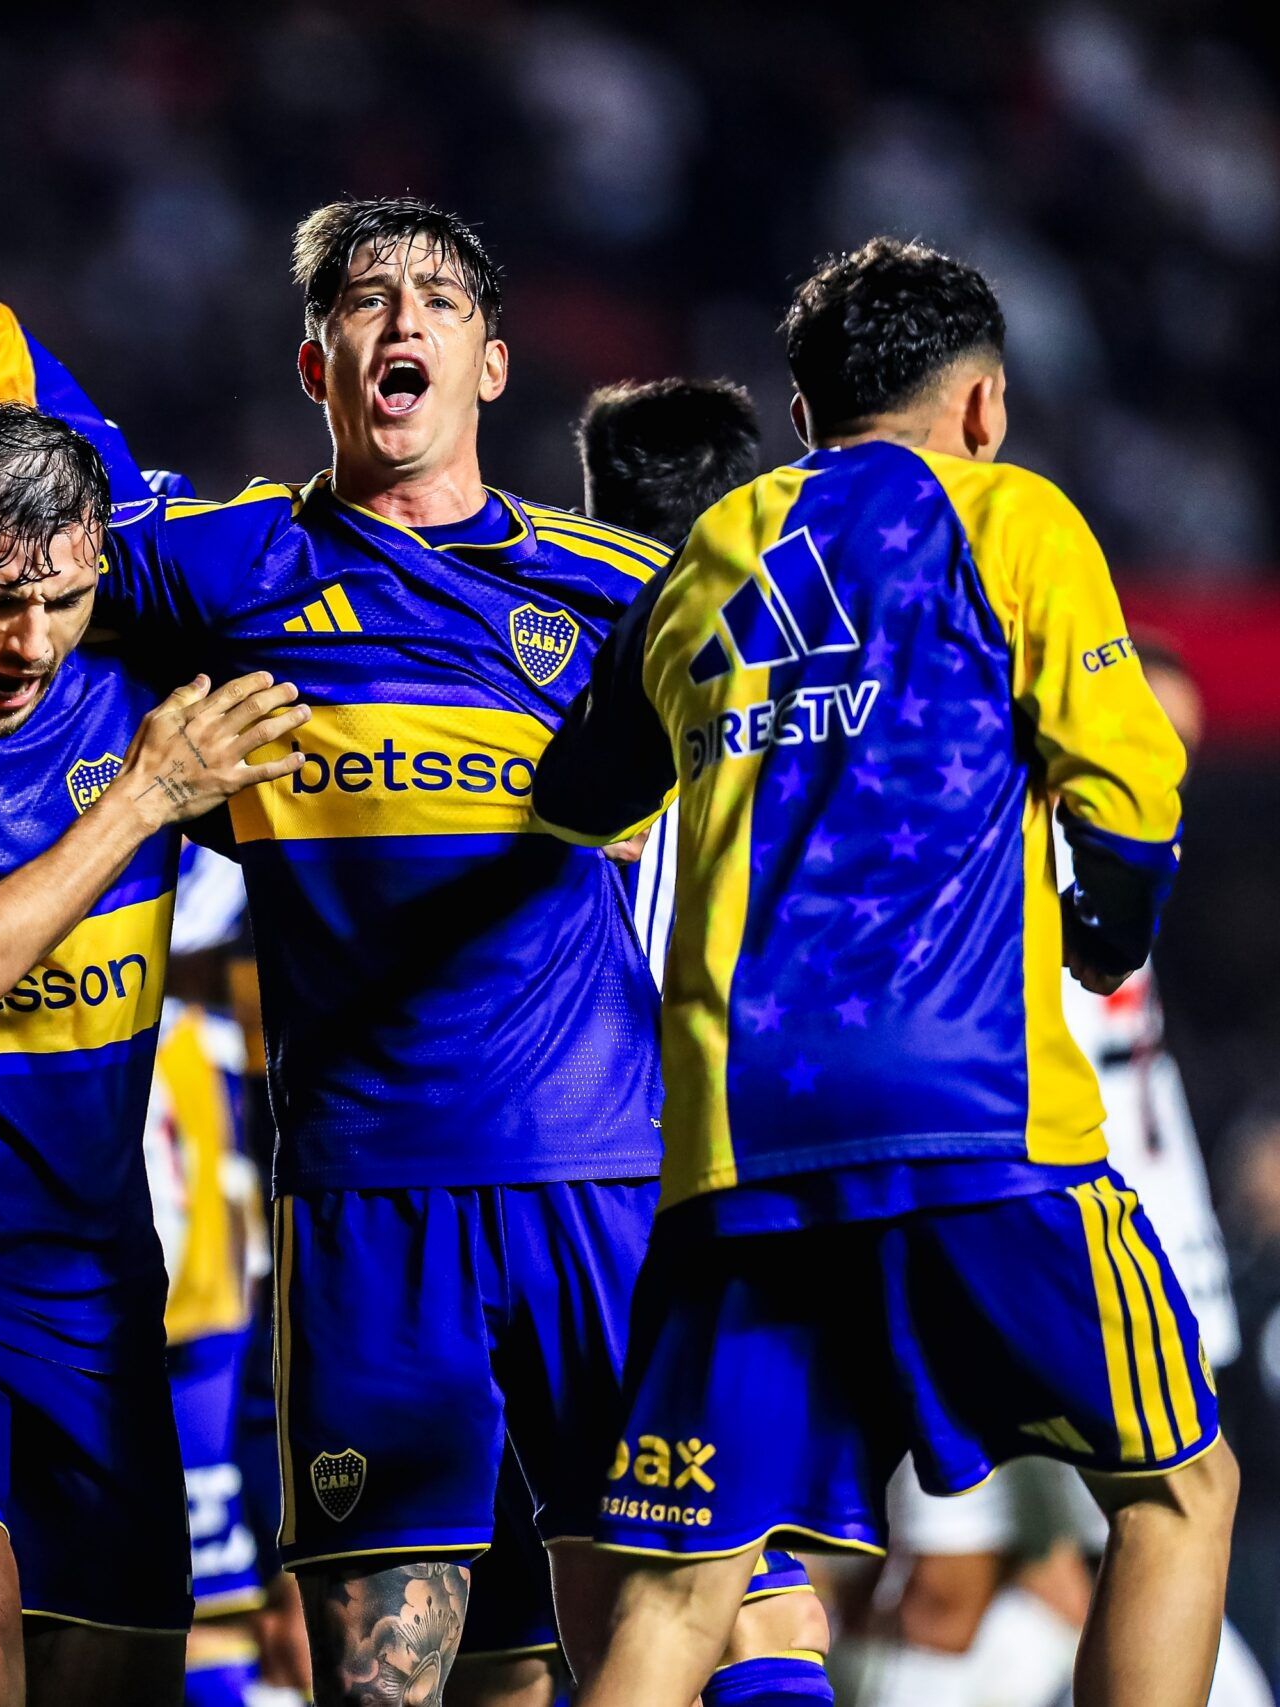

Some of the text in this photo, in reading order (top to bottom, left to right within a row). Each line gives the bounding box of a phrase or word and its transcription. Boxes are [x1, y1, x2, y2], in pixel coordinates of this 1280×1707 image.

[517, 629, 567, 654] CABJ
[1082, 637, 1136, 673] CET
[291, 738, 537, 797] betsso
[318, 1472, 359, 1491] CABJ
[599, 1495, 713, 1527] ssistance
